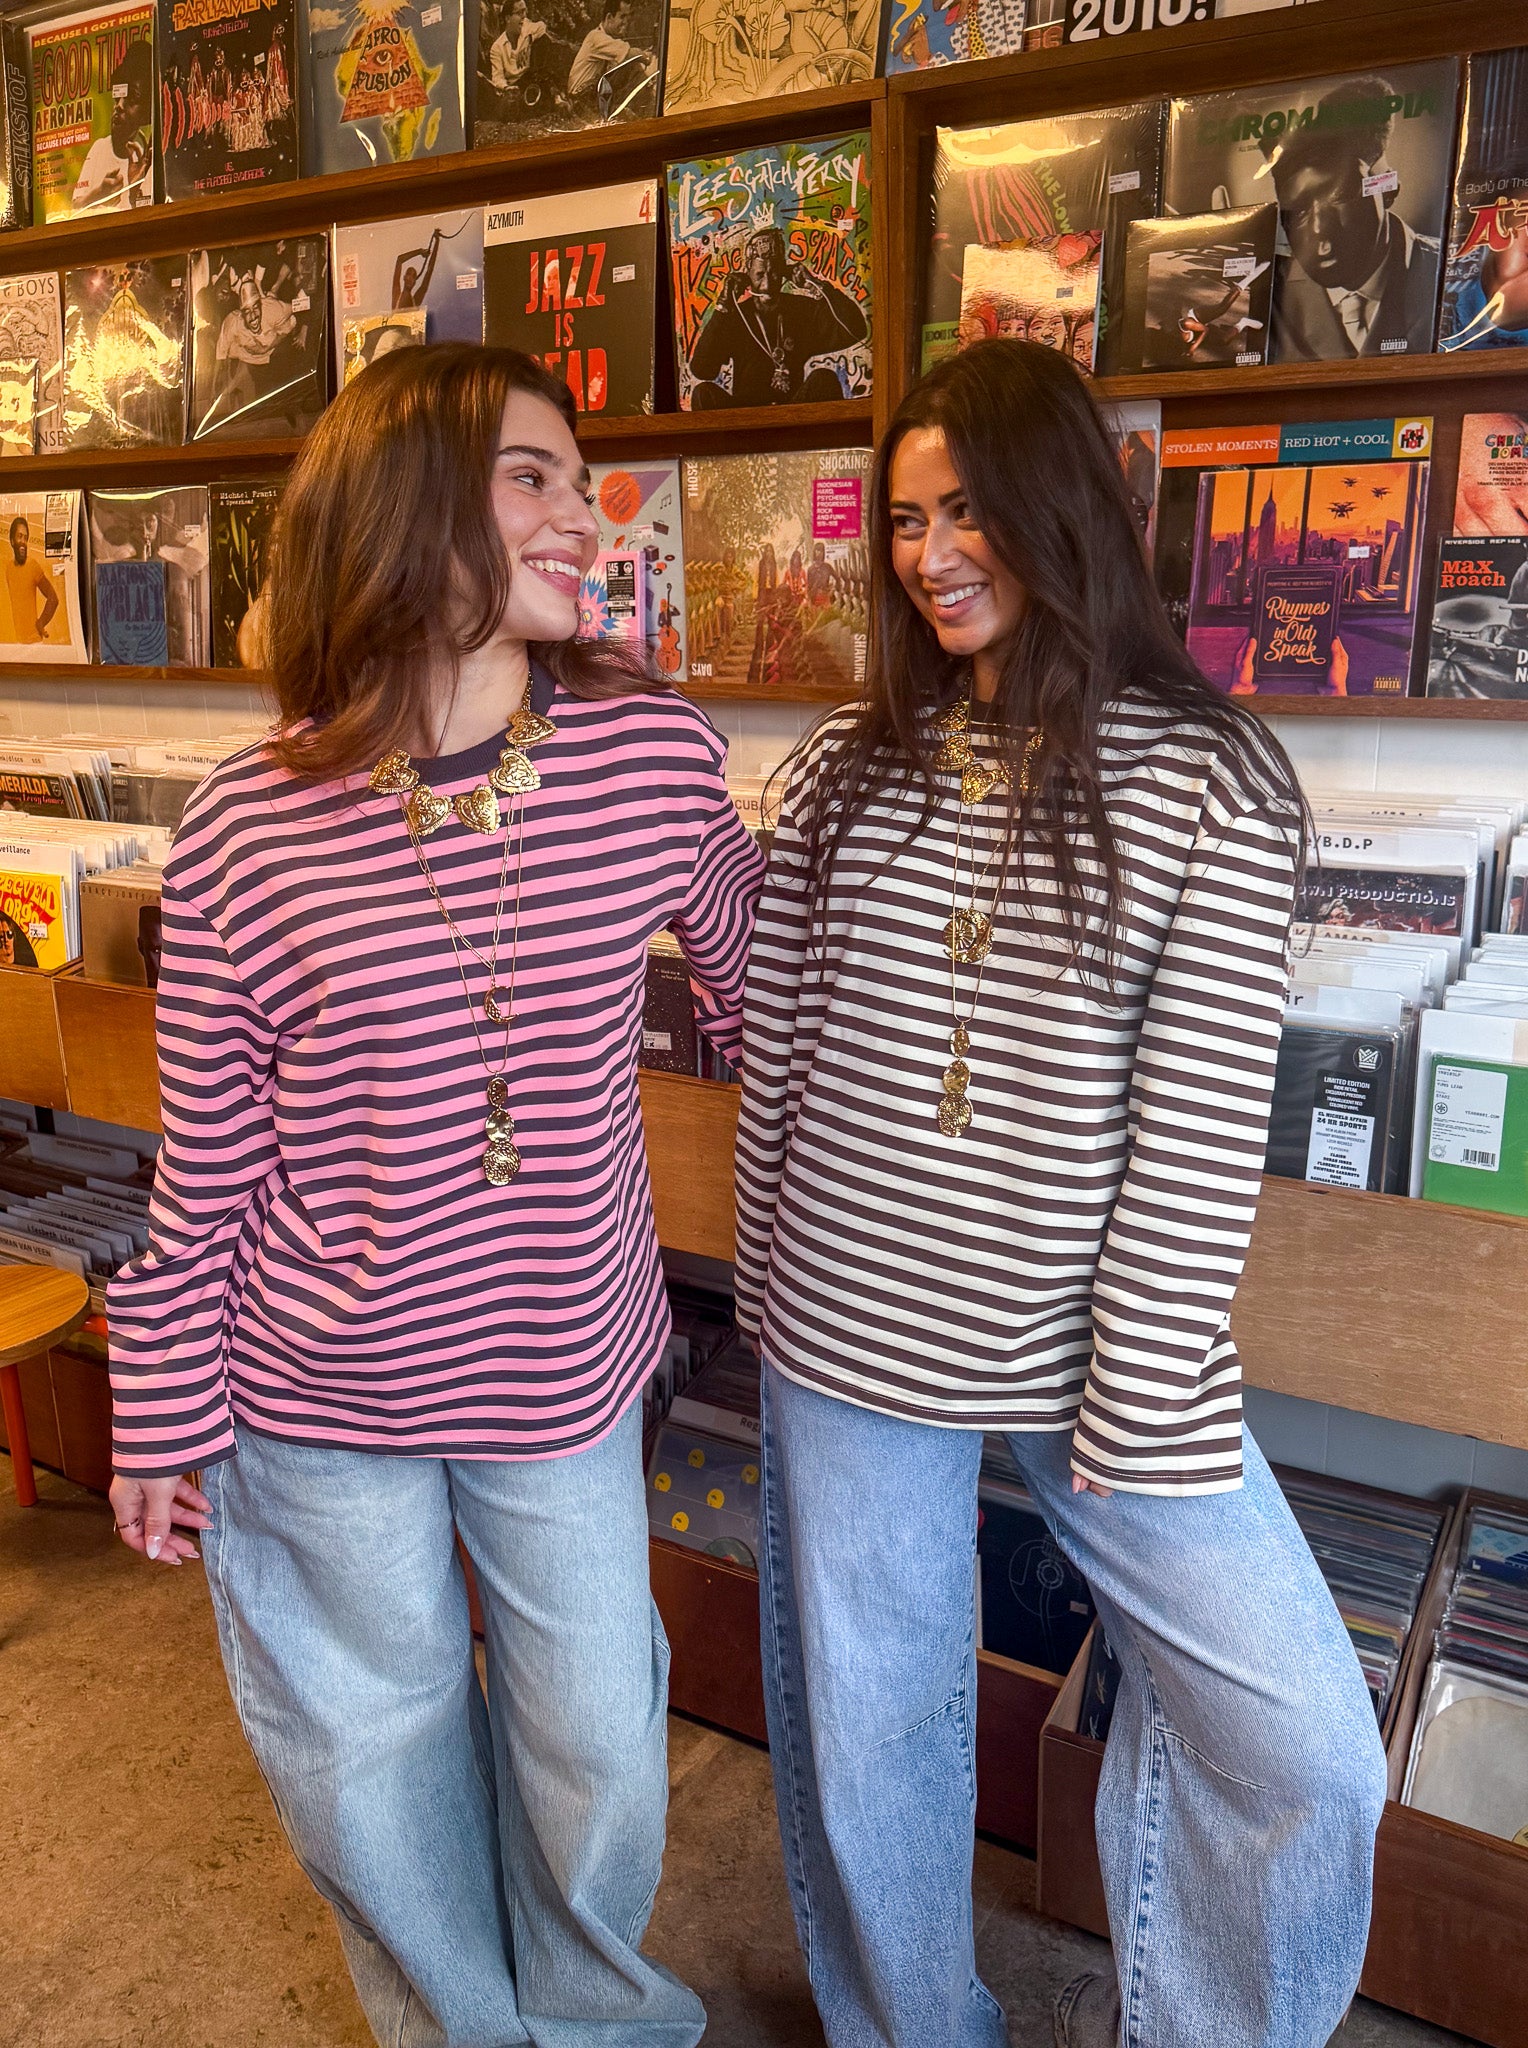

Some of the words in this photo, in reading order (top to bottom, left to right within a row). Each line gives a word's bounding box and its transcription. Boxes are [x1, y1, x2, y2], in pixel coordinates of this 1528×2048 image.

[33, 28, 81, 48] BECAUSE
[84, 26, 88, 34] I
[90, 19, 116, 32] GOT
[118, 10, 150, 24] HIGH
[1069, 0, 1207, 43] 2010
[364, 26, 401, 51] AFRO
[41, 39, 92, 107] GOOD
[95, 23, 151, 94] TIM
[353, 60, 412, 92] FUSION
[8, 63, 32, 190] STIKSTOF
[35, 97, 94, 134] AFROMAN
[36, 138, 59, 152] BECAUSE
[62, 134, 75, 146] GOT
[75, 131, 90, 143] HIGH
[678, 171, 728, 239] LEE
[790, 152, 862, 208] PERRY
[1465, 182, 1495, 195] Body
[638, 190, 652, 223] 4
[487, 209, 524, 231] AZYMUTH
[524, 241, 607, 315] JAZZ
[789, 229, 872, 301] SCRATCH
[555, 311, 574, 348] IS
[530, 347, 608, 412] AD
[1165, 442, 1213, 454] STOLEN
[1217, 439, 1279, 452] MOMENTS
[1284, 437, 1311, 449] RED
[1313, 435, 1341, 447] HOT
[1342, 436, 1352, 446] +
[1354, 434, 1389, 446] COOL
[819, 454, 869, 471] SHOCKING
[687, 460, 699, 499] THOSE
[220, 491, 249, 500] Michael
[1440, 571, 1506, 588] Roach
[1265, 595, 1331, 622] Rhymes
[1273, 627, 1285, 640] in
[1285, 620, 1318, 642] Old
[854, 633, 867, 682] SHAKING
[1263, 638, 1326, 665] Speak
[691, 663, 713, 677] DAYS
[81, 885, 111, 897] GRACE
[115, 888, 145, 901] JONES
[1337, 885, 1457, 907] PRODUCTIONS
[1323, 1076, 1347, 1085] LIMITED
[1347, 1080, 1370, 1089] EDITION
[1339, 1120, 1368, 1130] SPORTS
[19, 1241, 32, 1252] VAN
[33, 1245, 52, 1257] VEEN
